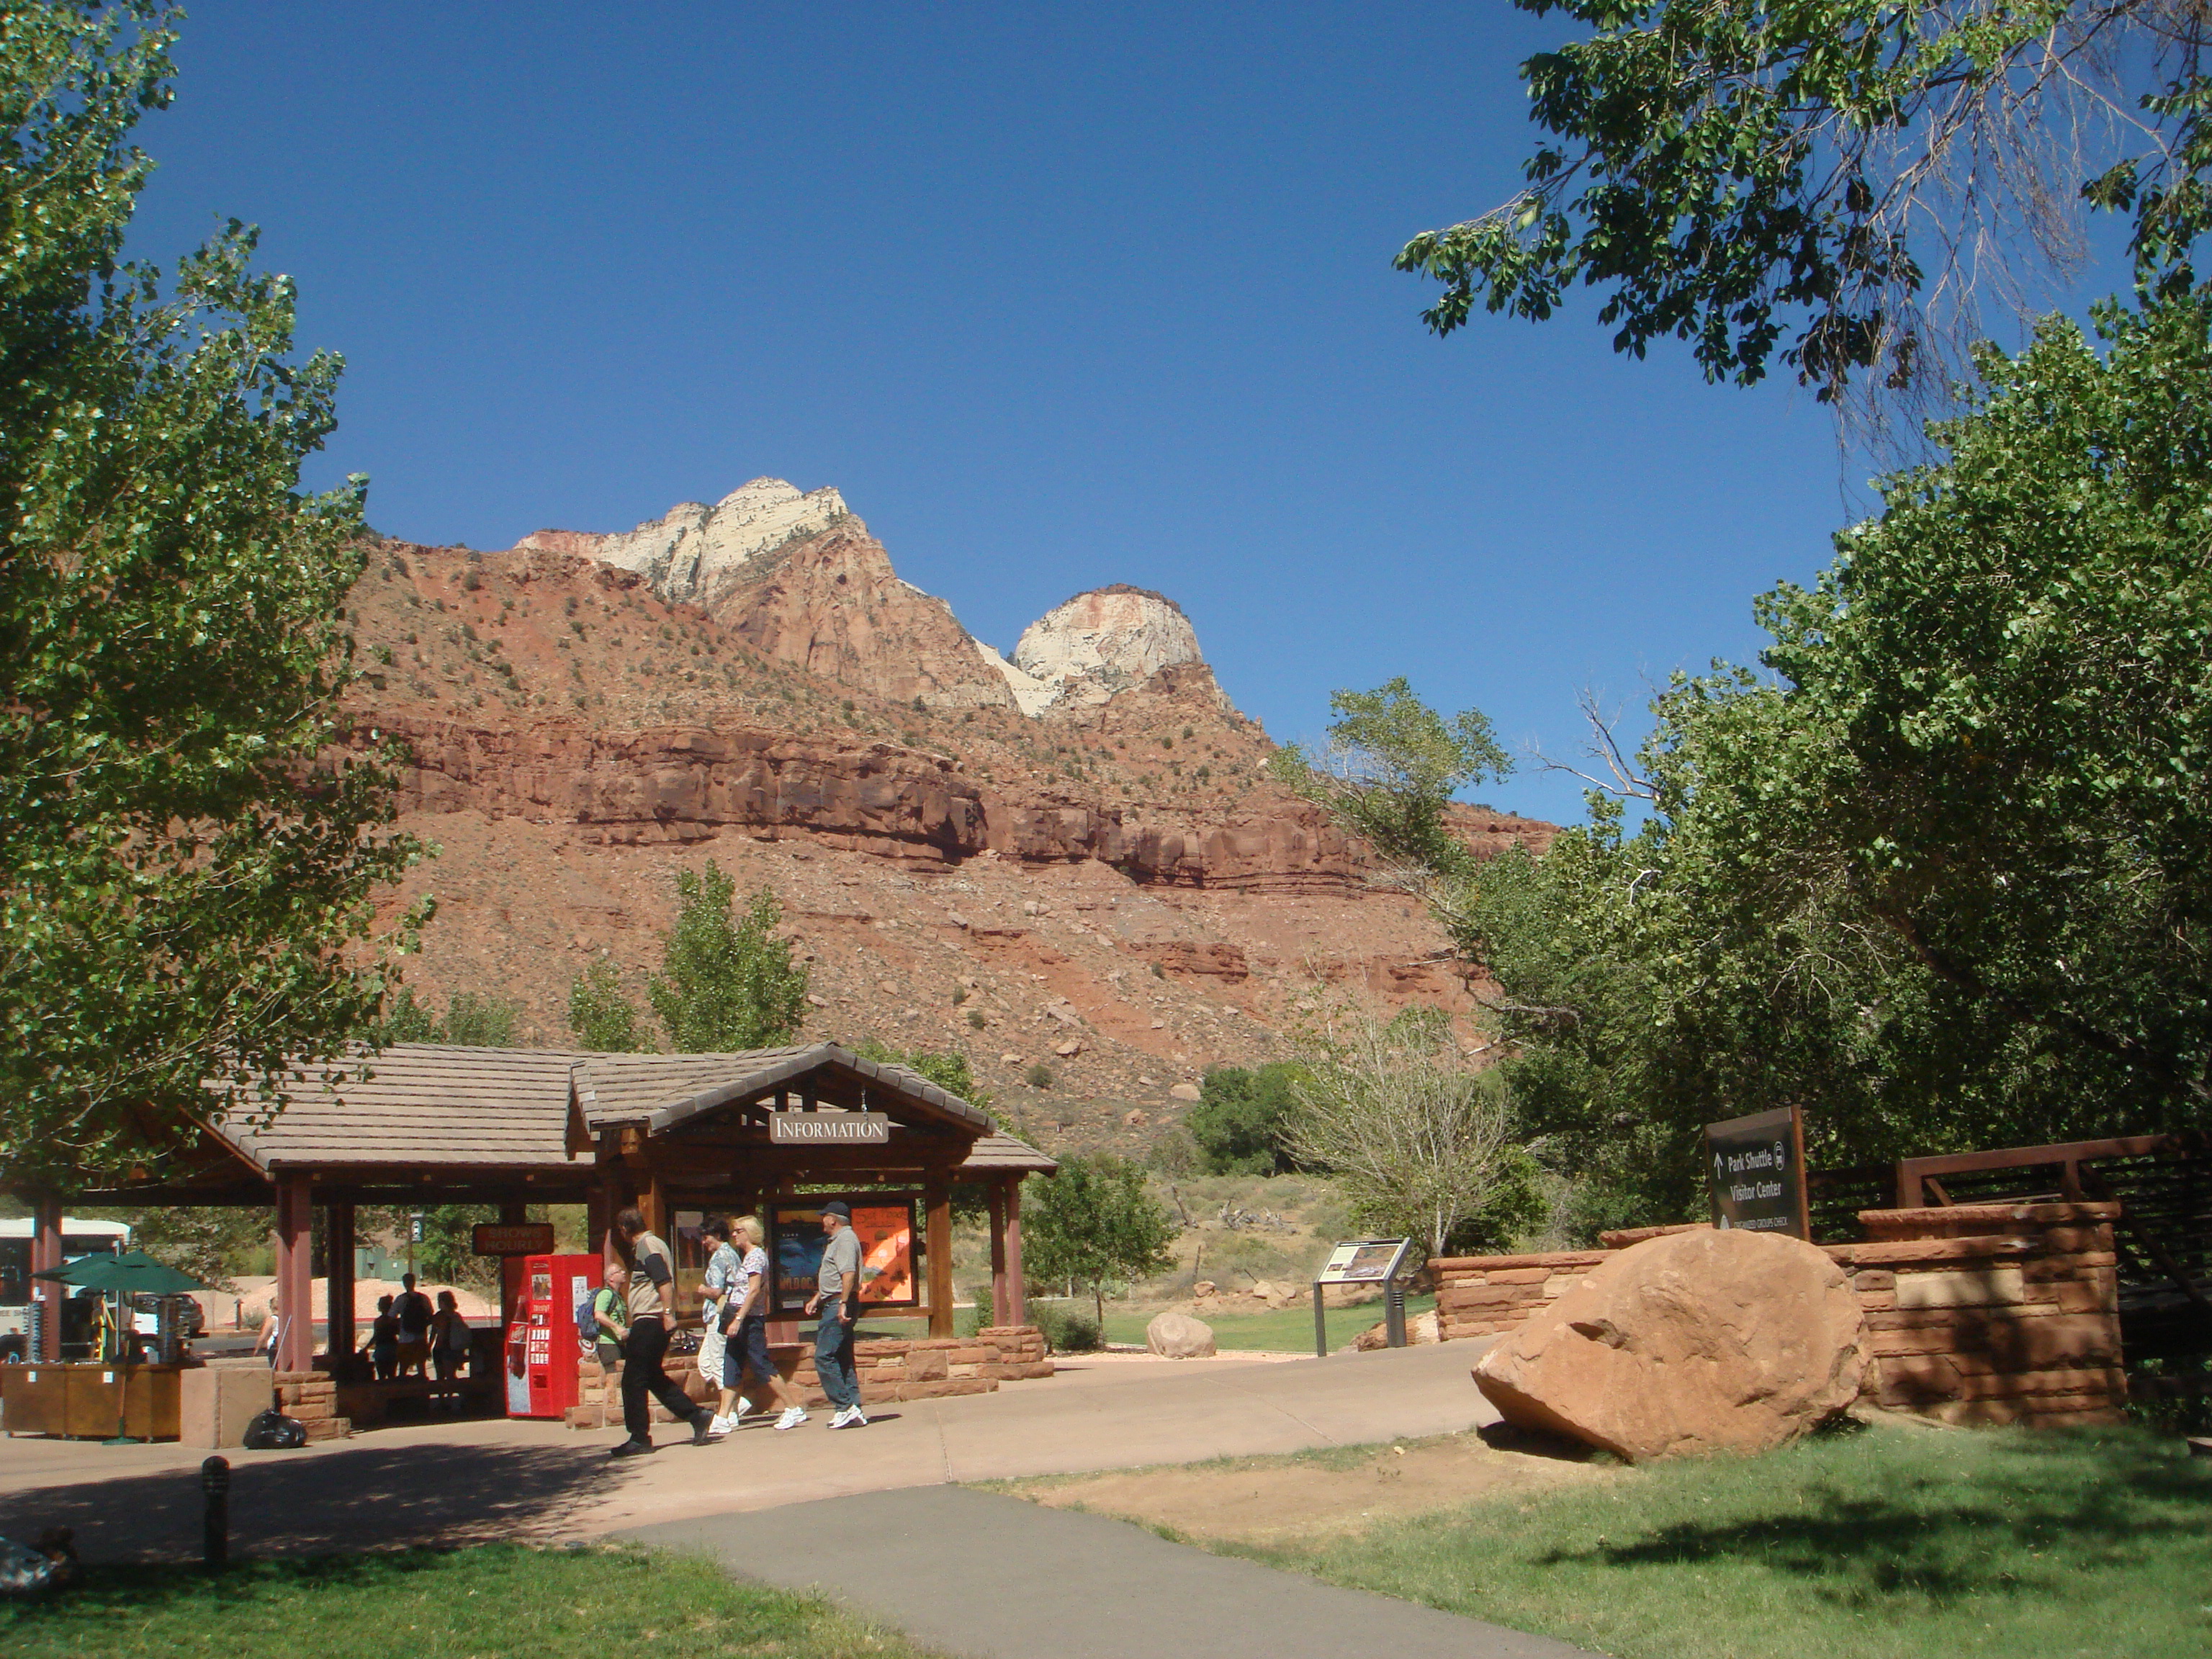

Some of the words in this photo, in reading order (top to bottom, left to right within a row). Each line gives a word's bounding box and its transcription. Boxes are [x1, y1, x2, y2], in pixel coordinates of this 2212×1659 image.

[775, 1118, 884, 1138] INFORMATION
[1727, 1154, 1745, 1172] Park
[1745, 1149, 1772, 1169] Shuttle
[1730, 1184, 1755, 1201] Visitor
[1756, 1181, 1781, 1198] Center
[1757, 1218, 1773, 1228] GROUPS
[1774, 1216, 1788, 1227] CHECK
[487, 1227, 543, 1238] SHOWS
[485, 1240, 544, 1251] HOURLY
